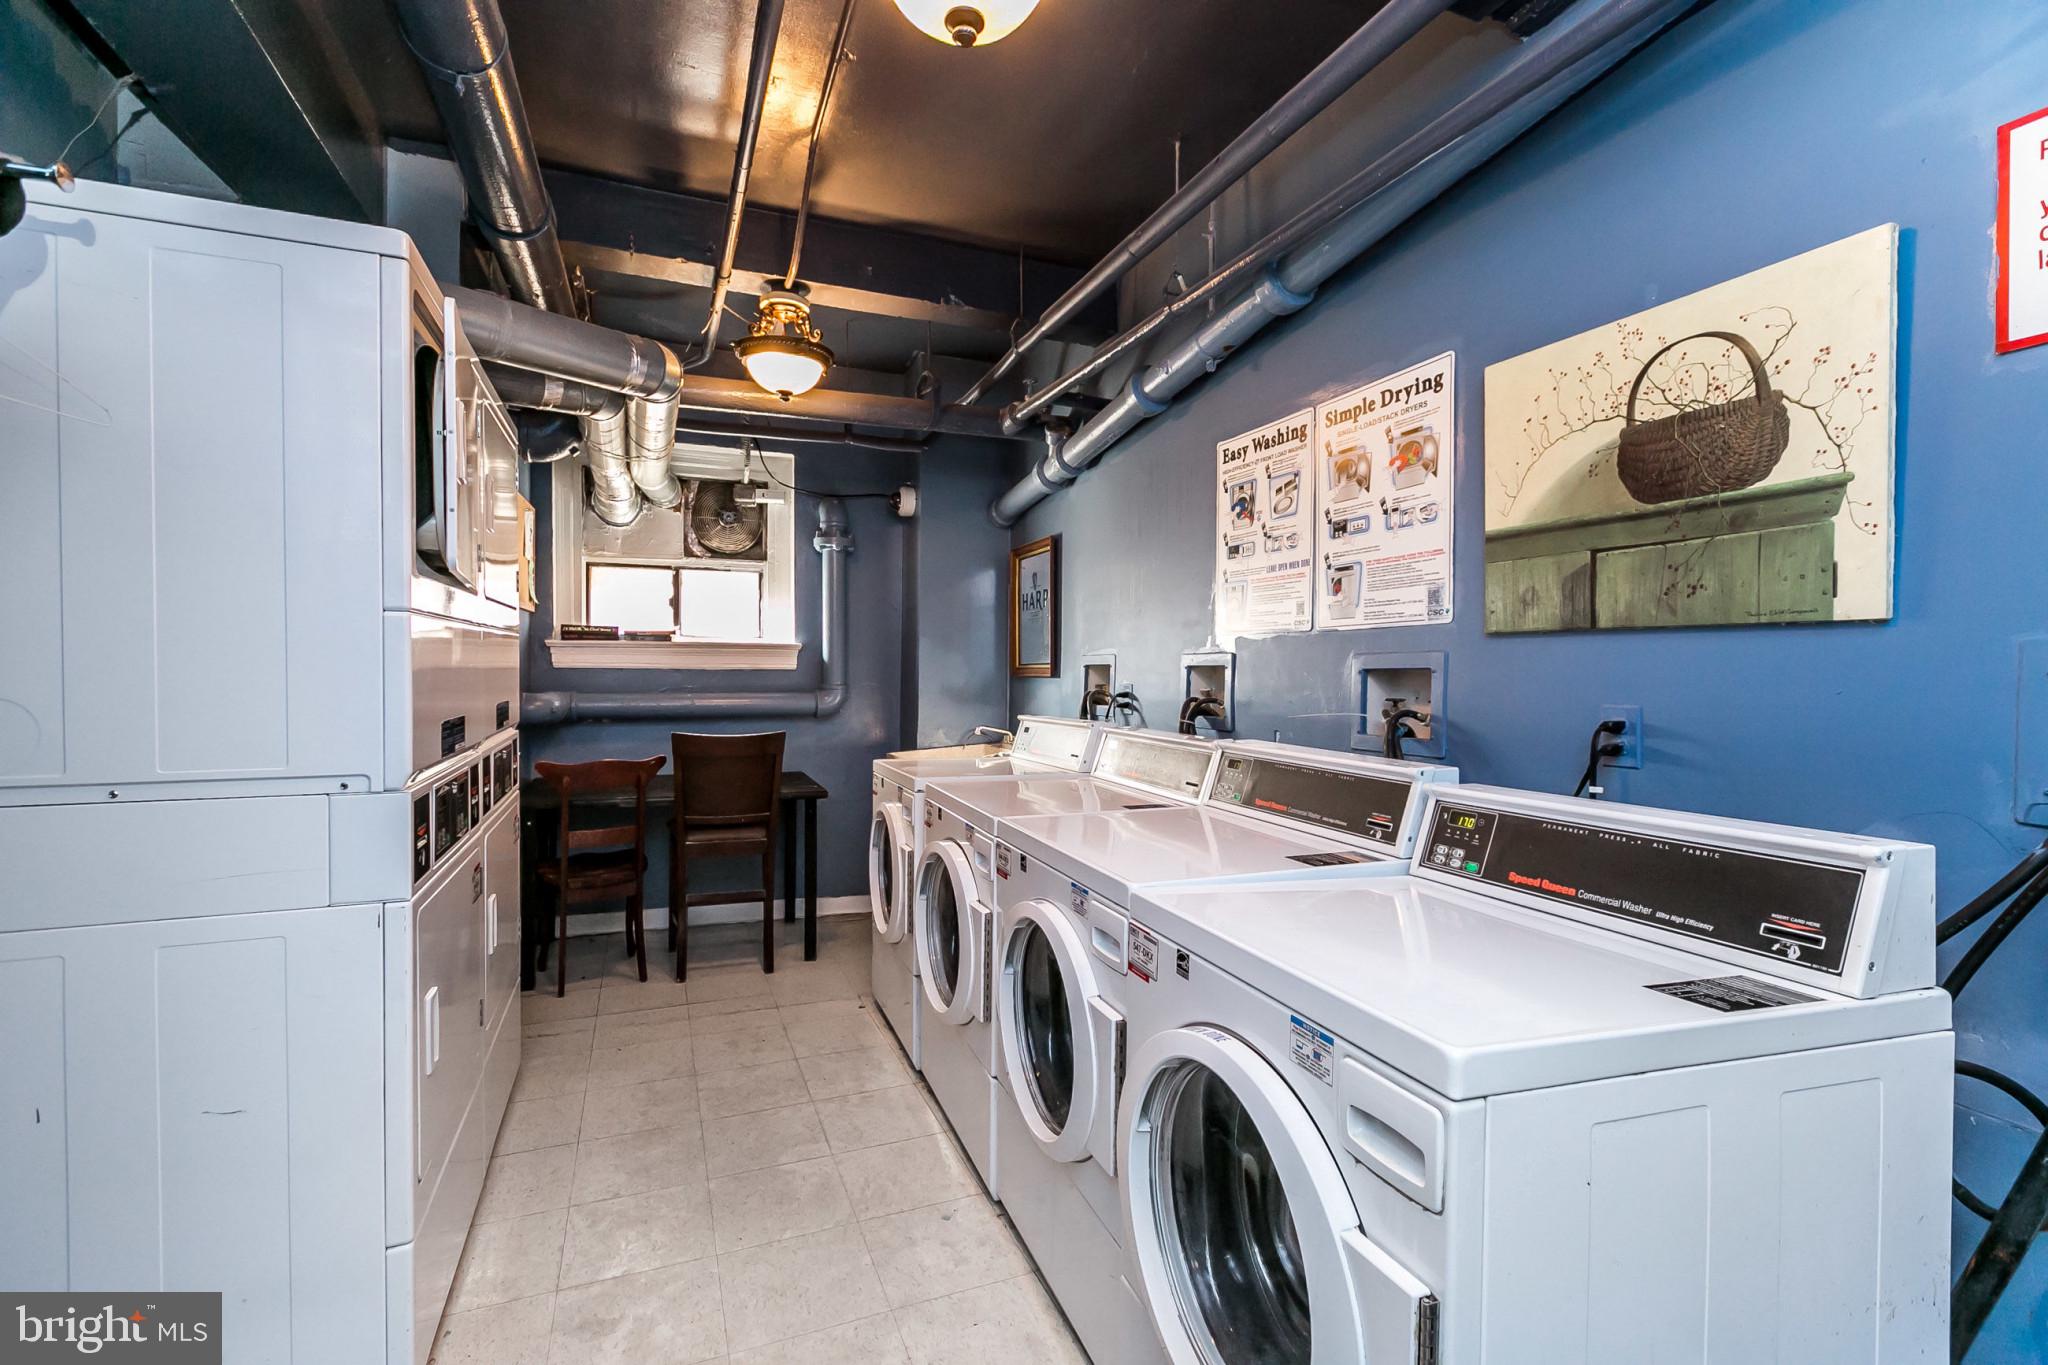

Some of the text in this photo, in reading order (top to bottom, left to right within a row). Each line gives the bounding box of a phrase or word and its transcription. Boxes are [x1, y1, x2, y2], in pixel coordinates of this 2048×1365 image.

[1325, 397, 1376, 428] Simple
[1380, 372, 1444, 408] Drying
[1400, 400, 1428, 415] DRYERS
[1222, 445, 1249, 464] Easy
[1252, 424, 1307, 453] Washing
[1275, 449, 1287, 460] LOAD
[1278, 562, 1288, 571] OPEN
[1022, 589, 1048, 611] HARP
[1458, 816, 1475, 828] 170
[1542, 823, 1720, 859] PERMANENT PRESS ALL FABRIC
[1508, 871, 1714, 932] Speed Queen Commercial Washer Ultra High Efficiency
[1771, 913, 1790, 921] INSERT
